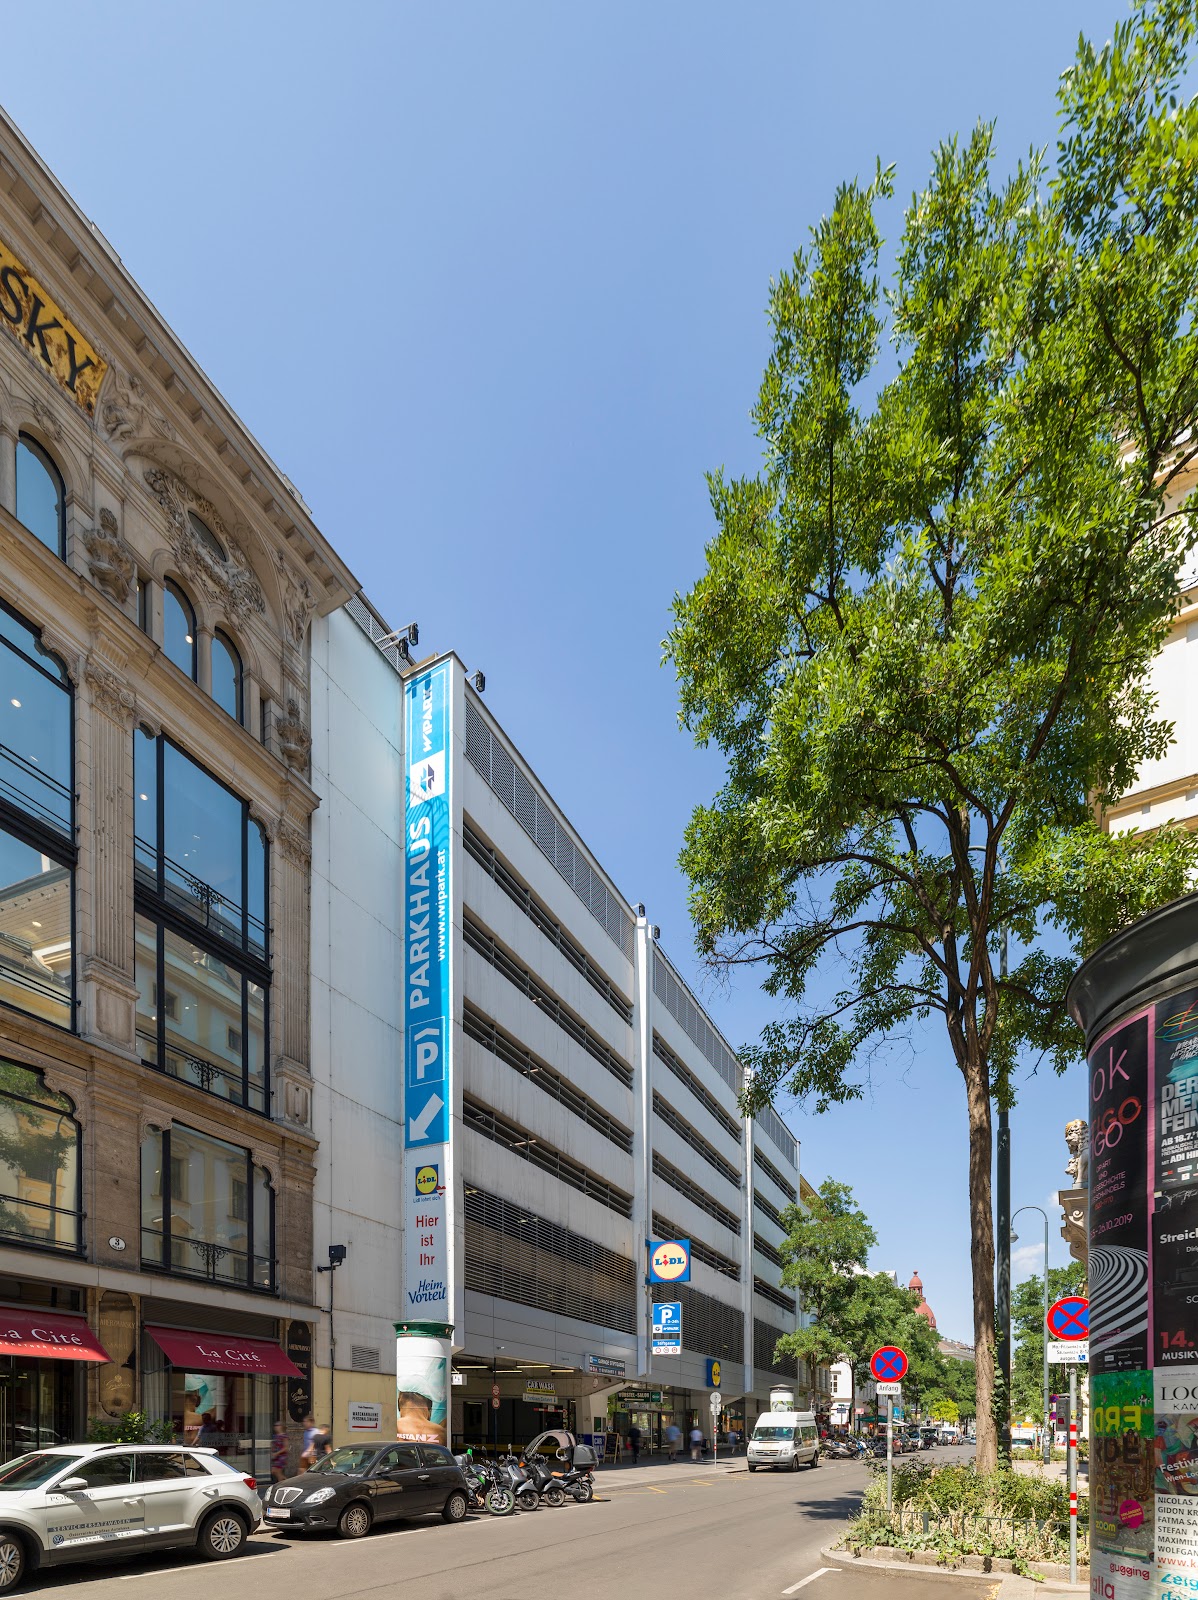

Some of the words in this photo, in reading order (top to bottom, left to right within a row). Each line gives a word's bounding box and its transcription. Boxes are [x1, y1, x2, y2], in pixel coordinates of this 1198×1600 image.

[436, 848, 446, 963] www.wipark.at
[410, 815, 431, 1010] PARKHAUS
[1161, 1137, 1174, 1148] AB
[1170, 1153, 1185, 1164] ADI
[416, 1214, 439, 1228] Hier
[421, 1234, 434, 1247] ist
[420, 1253, 435, 1266] Ihr
[418, 1279, 443, 1293] Heim
[408, 1287, 446, 1304] Vorteil
[31, 1328, 83, 1346] Cité
[1160, 1330, 1195, 1349] 14.
[196, 1345, 221, 1358] La
[225, 1349, 261, 1362] Cité
[878, 1384, 899, 1392] Anfang
[1158, 1497, 1193, 1506] NICOLAS
[1158, 1507, 1184, 1515] GIDON
[1158, 1516, 1185, 1525] FATMA
[1158, 1526, 1187, 1535] STEFAN
[1158, 1557, 1198, 1569] www.k
[1110, 1563, 1150, 1581] gugging
[1091, 1576, 1115, 1600] alla
